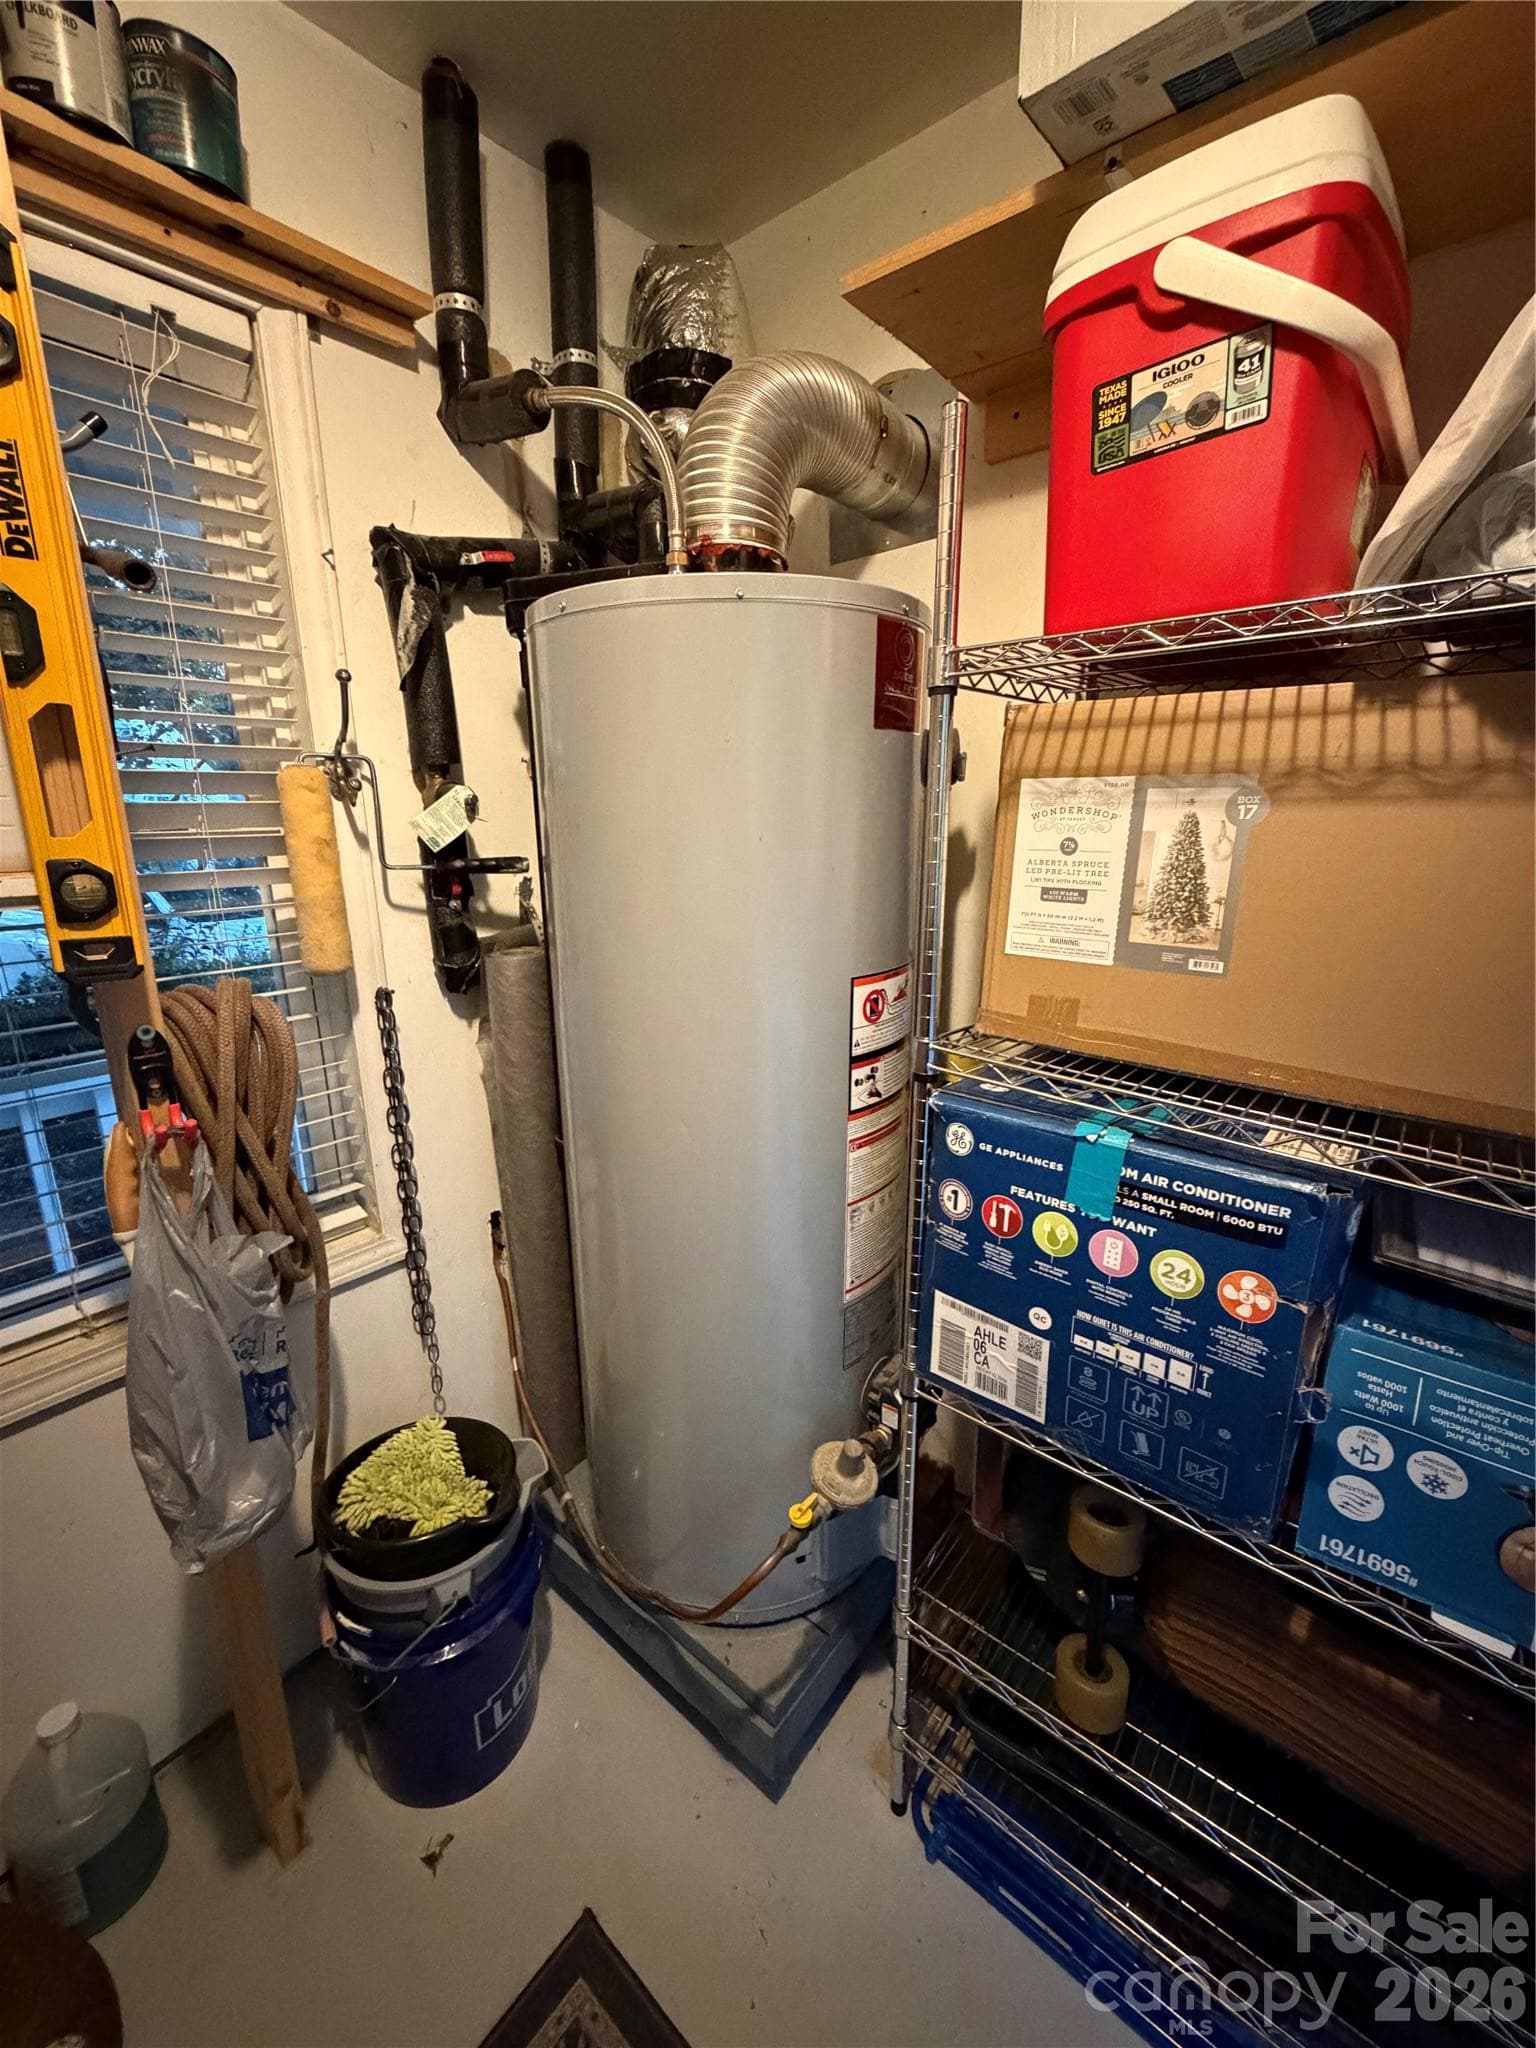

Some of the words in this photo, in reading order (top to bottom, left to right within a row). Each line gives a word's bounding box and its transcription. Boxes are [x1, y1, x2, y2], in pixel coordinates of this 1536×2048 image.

[1152, 354, 1205, 382] IGLOO
[1238, 354, 1261, 372] 41
[1099, 380, 1127, 396] TEXAS
[1162, 373, 1194, 389] COOLER
[1098, 388, 1127, 405] MADE
[1098, 403, 1127, 419] SINCE
[1098, 411, 1126, 430] 1947
[1237, 796, 1262, 804] BOX
[1031, 806, 1118, 821] WONDERSHOP
[1238, 804, 1258, 820] 17
[1026, 867, 1042, 875] LED
[1085, 870, 1110, 878] TREE
[1027, 859, 1068, 867] ALBERTA
[1072, 861, 1110, 869] SPRUCE
[979, 1143, 993, 1153] GE
[995, 1147, 1064, 1172] APPLIANCES
[1010, 1185, 1076, 1213] FEATURES
[1141, 1172, 1169, 1188] AIR
[1172, 1180, 1292, 1219] CONDITIONER
[1122, 1199, 1140, 1210] 250
[1141, 1204, 1158, 1214] SQ.
[1159, 1209, 1175, 1220] FT.
[1131, 1190, 1141, 1198] A
[1141, 1192, 1177, 1210] SMALL
[1179, 1202, 1214, 1219] ROOM
[1222, 1214, 1256, 1230] 6000
[1257, 1223, 1284, 1236] BTU
[1112, 1216, 1158, 1238] WANT
[1160, 1262, 1192, 1284] 24
[1243, 1292, 1251, 1301] 3
[1033, 1312, 1047, 1324] QC
[974, 1326, 1007, 1351] AHLE
[1077, 1309, 1093, 1320] HOW
[1093, 1313, 1110, 1328] QUIET
[1111, 1321, 1118, 1331] IS
[1119, 1324, 1132, 1337] THIS
[1134, 1331, 1145, 1342] AIR
[1146, 1334, 1194, 1360] CONDITIONER?
[1362, 1319, 1464, 1358] #5691761
[973, 1339, 987, 1354] 06
[973, 1352, 990, 1369] CA
[1357, 1371, 1383, 1385] vatios
[1368, 1383, 1393, 1398] Hasta
[1385, 1380, 1408, 1394] 1000
[1353, 1389, 1379, 1405] Watts
[1132, 1400, 1159, 1419] UP
[1364, 1402, 1375, 1411] to
[1376, 1405, 1390, 1417] Up
[1381, 1399, 1404, 1413] 1000
[1436, 1388, 1534, 1425] sobrecalentamiento
[1457, 1405, 1466, 1413] el
[1429, 1404, 1488, 1428] antivuelco
[1467, 1406, 1502, 1424] contra
[1502, 1418, 1509, 1427] y
[1359, 1428, 1380, 1439] QUIET
[1431, 1416, 1481, 1438] Protection
[1357, 1434, 1379, 1445] ULTRA
[1446, 1431, 1464, 1443] and
[1483, 1434, 1530, 1456] Overheat
[1466, 1436, 1511, 1459] Tip-Over
[1413, 1459, 1463, 1482] COOL-TOUCH
[1422, 1455, 1457, 1473] HOUSING
[1335, 1481, 1379, 1501] OSCILLATION
[1319, 1534, 1418, 1588] #5691761
